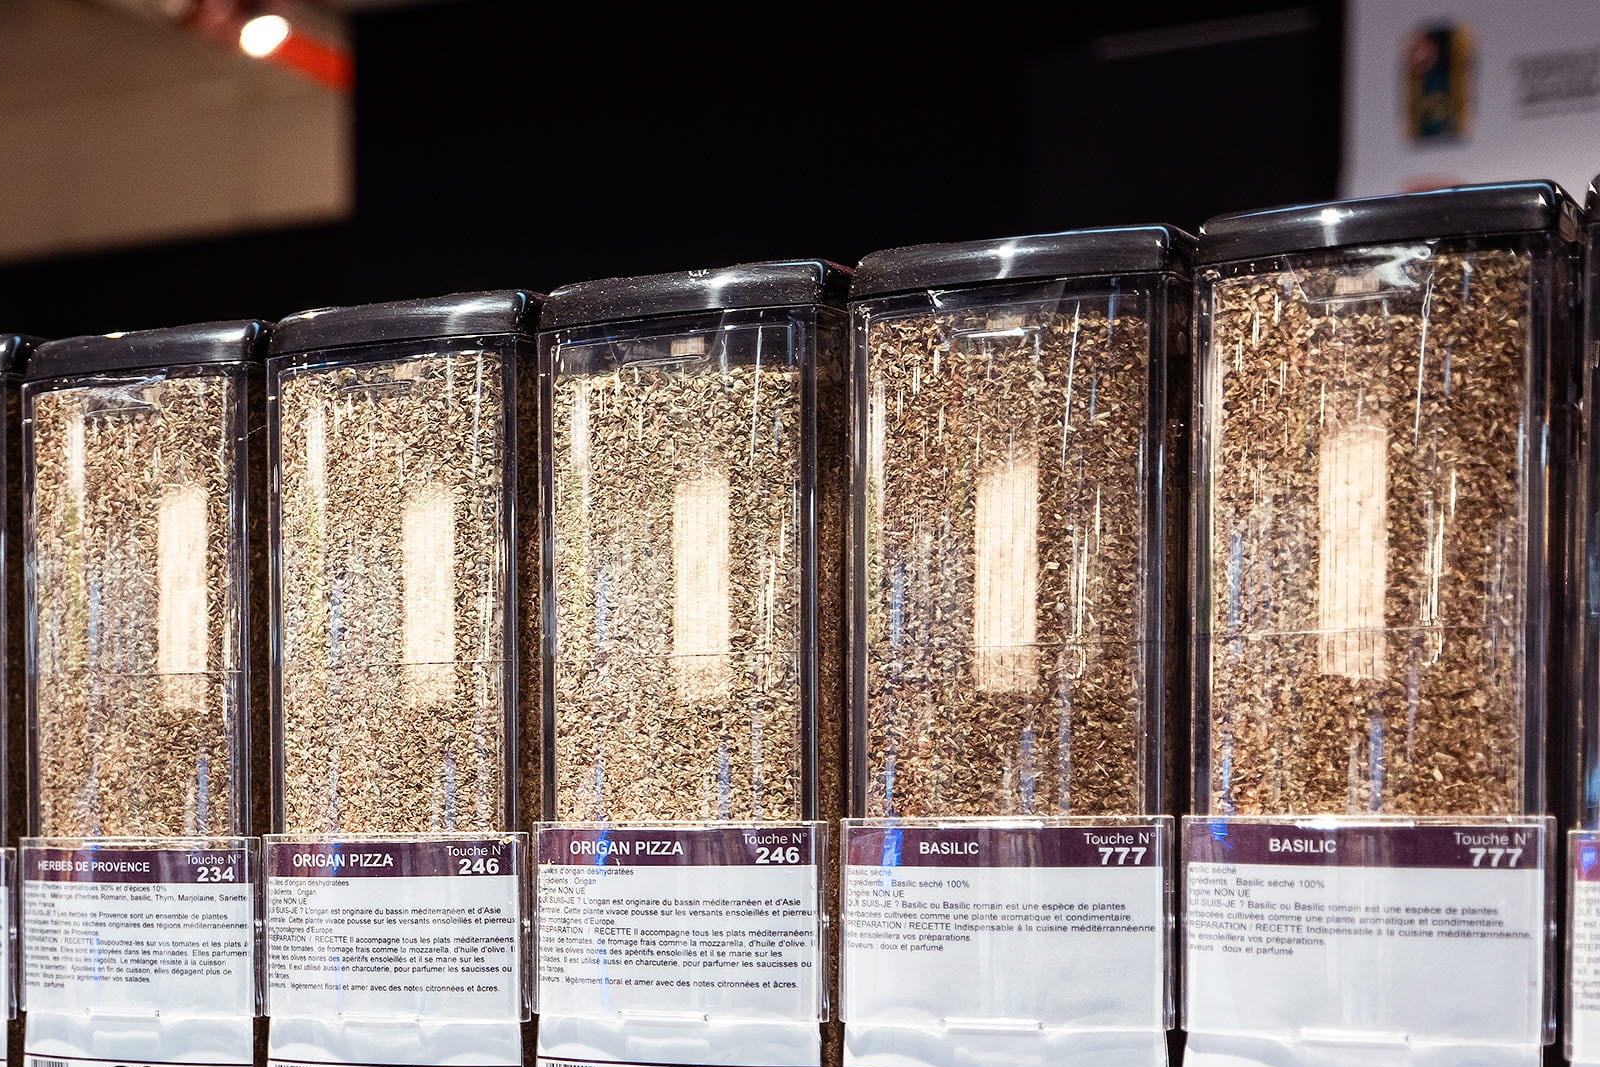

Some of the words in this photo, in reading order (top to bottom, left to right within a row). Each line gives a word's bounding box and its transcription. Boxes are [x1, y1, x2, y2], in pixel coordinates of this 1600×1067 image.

[742, 833, 788, 844] Touche
[1084, 833, 1134, 844] Touche
[1454, 833, 1509, 846] Touche
[446, 846, 488, 856] Touche
[570, 841, 630, 855] ORIGAN
[635, 841, 684, 855] PIZZA
[919, 841, 979, 855] BASILIC
[1269, 838, 1337, 853] BASILIC
[185, 854, 224, 865] Touche
[293, 853, 345, 868] ORIGAN
[350, 853, 394, 867] PIZZA
[756, 847, 800, 864] 246
[1098, 847, 1147, 865] 777
[1470, 848, 1522, 867] 777
[38, 861, 73, 871] HERBES
[76, 861, 87, 872] DE
[91, 861, 150, 872] PROVENCE
[459, 858, 499, 875] 246
[197, 867, 234, 882] 234
[1236, 878, 1265, 886] Basilic
[1299, 880, 1325, 888] 100%
[1215, 889, 1235, 897] NON
[626, 899, 659, 907] originaire
[862, 900, 892, 908] SUIS-JE
[1042, 903, 1074, 912] espèce
[1093, 903, 1126, 912] plantes
[884, 911, 917, 919] cultivées
[971, 913, 998, 922] plante
[909, 922, 951, 930] RECETTE
[954, 924, 1014, 933] Indispensable
[641, 929, 689, 938] accompagne
[727, 930, 745, 938] plats
[910, 944, 943, 952] parfumé
[1223, 945, 1241, 953] doux
[718, 980, 759, 988] citronnées
